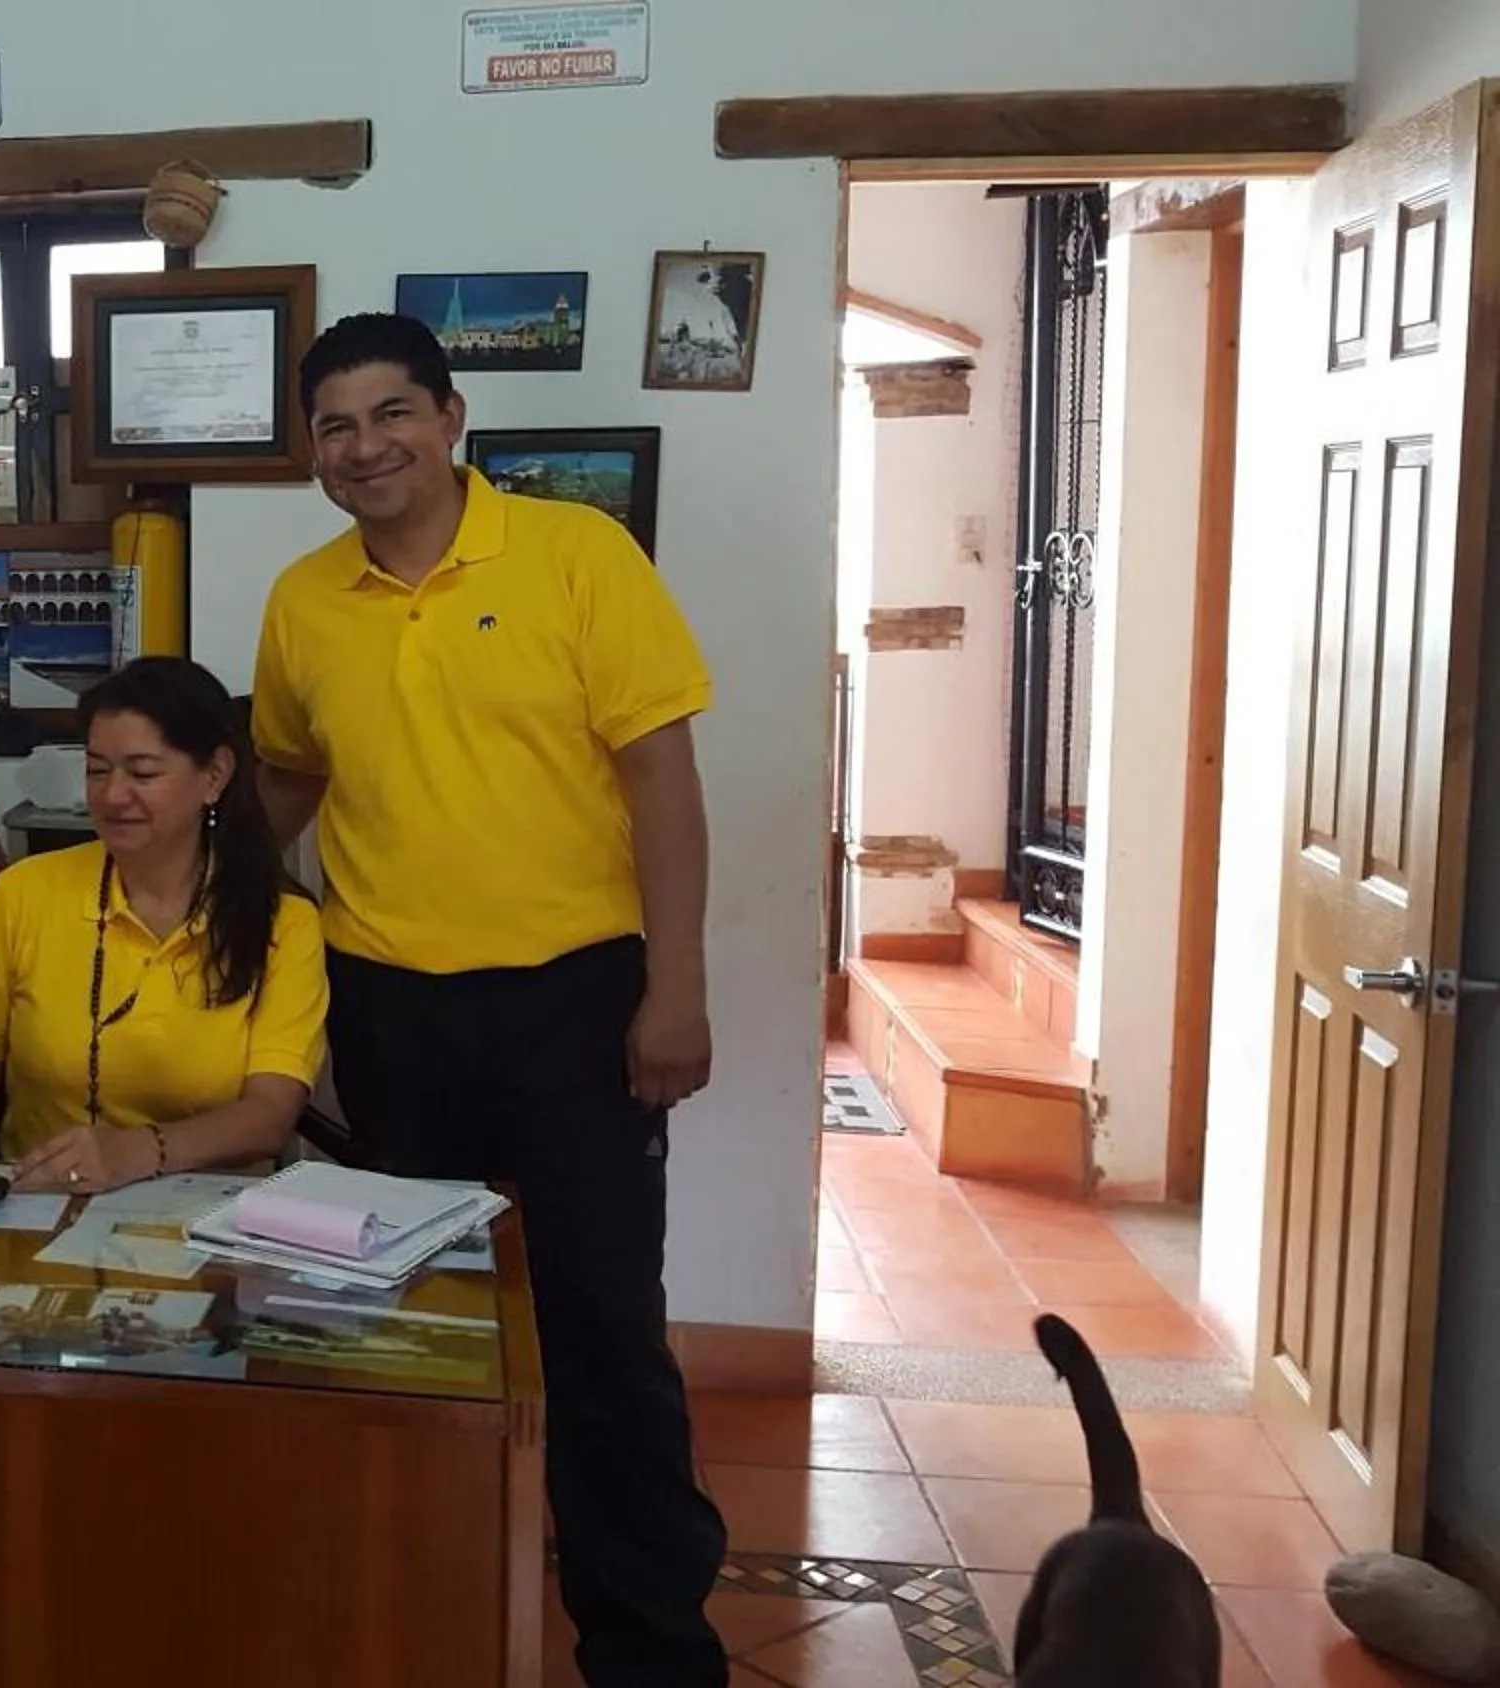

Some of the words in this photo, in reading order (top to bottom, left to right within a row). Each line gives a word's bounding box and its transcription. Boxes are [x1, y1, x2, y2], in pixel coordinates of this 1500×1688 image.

[493, 57, 537, 79] FAVOR
[541, 56, 560, 76] NO
[564, 54, 613, 74] FUMAR
